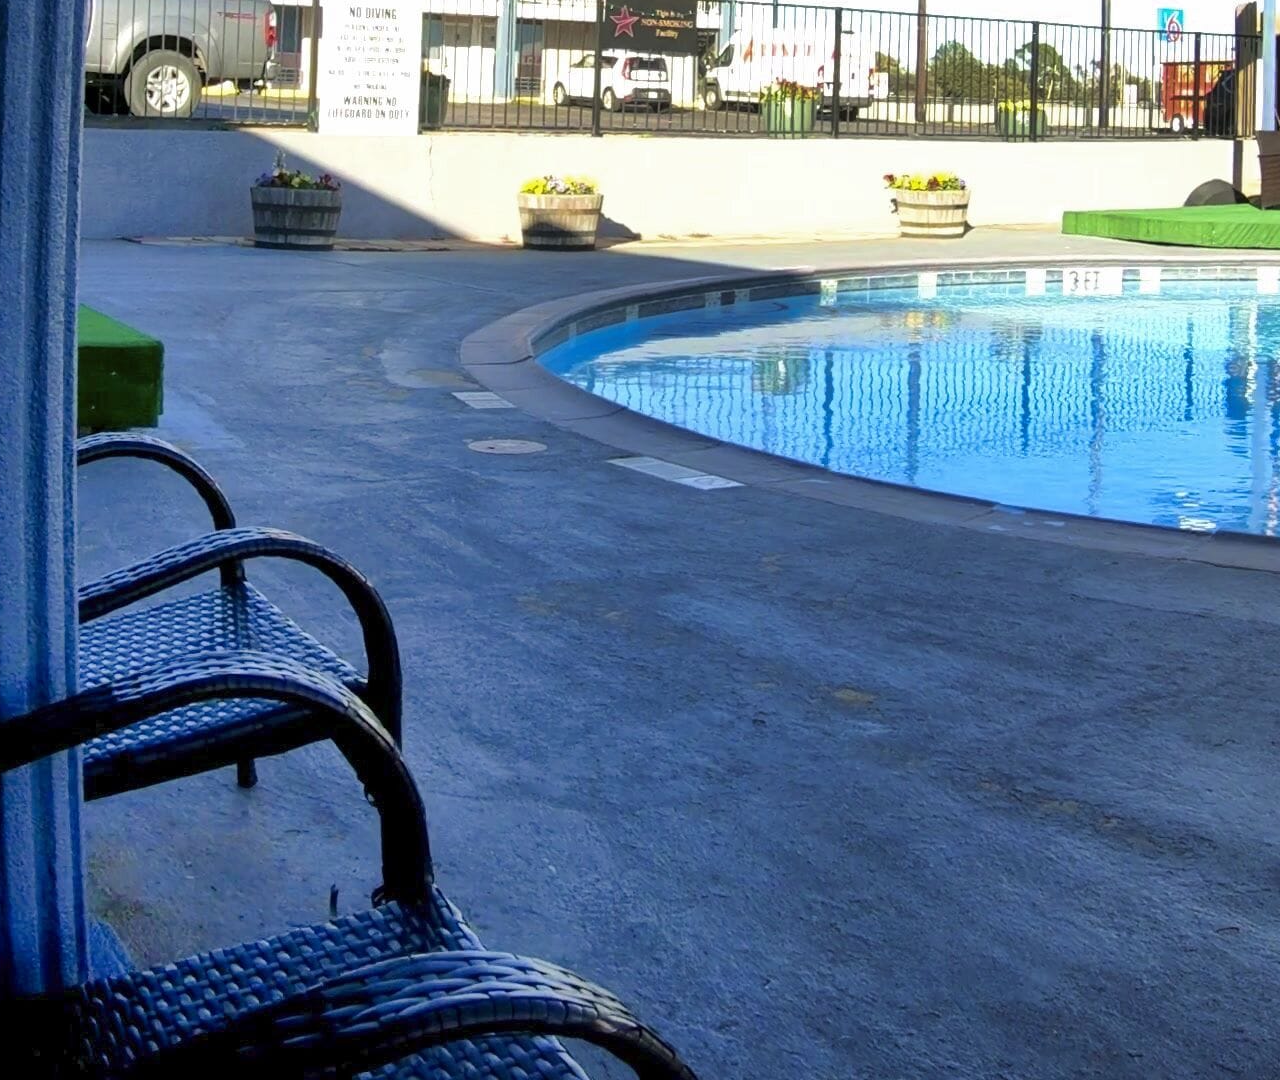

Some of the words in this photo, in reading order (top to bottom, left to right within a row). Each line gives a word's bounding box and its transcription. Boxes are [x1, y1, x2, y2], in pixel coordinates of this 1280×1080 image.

[349, 6, 362, 18] NO
[365, 7, 397, 20] DIVING
[641, 18, 694, 29] NON-SMOKING
[1166, 10, 1183, 42] 6
[343, 96, 383, 106] WARNING
[386, 96, 397, 107] NO
[375, 108, 386, 119] ON
